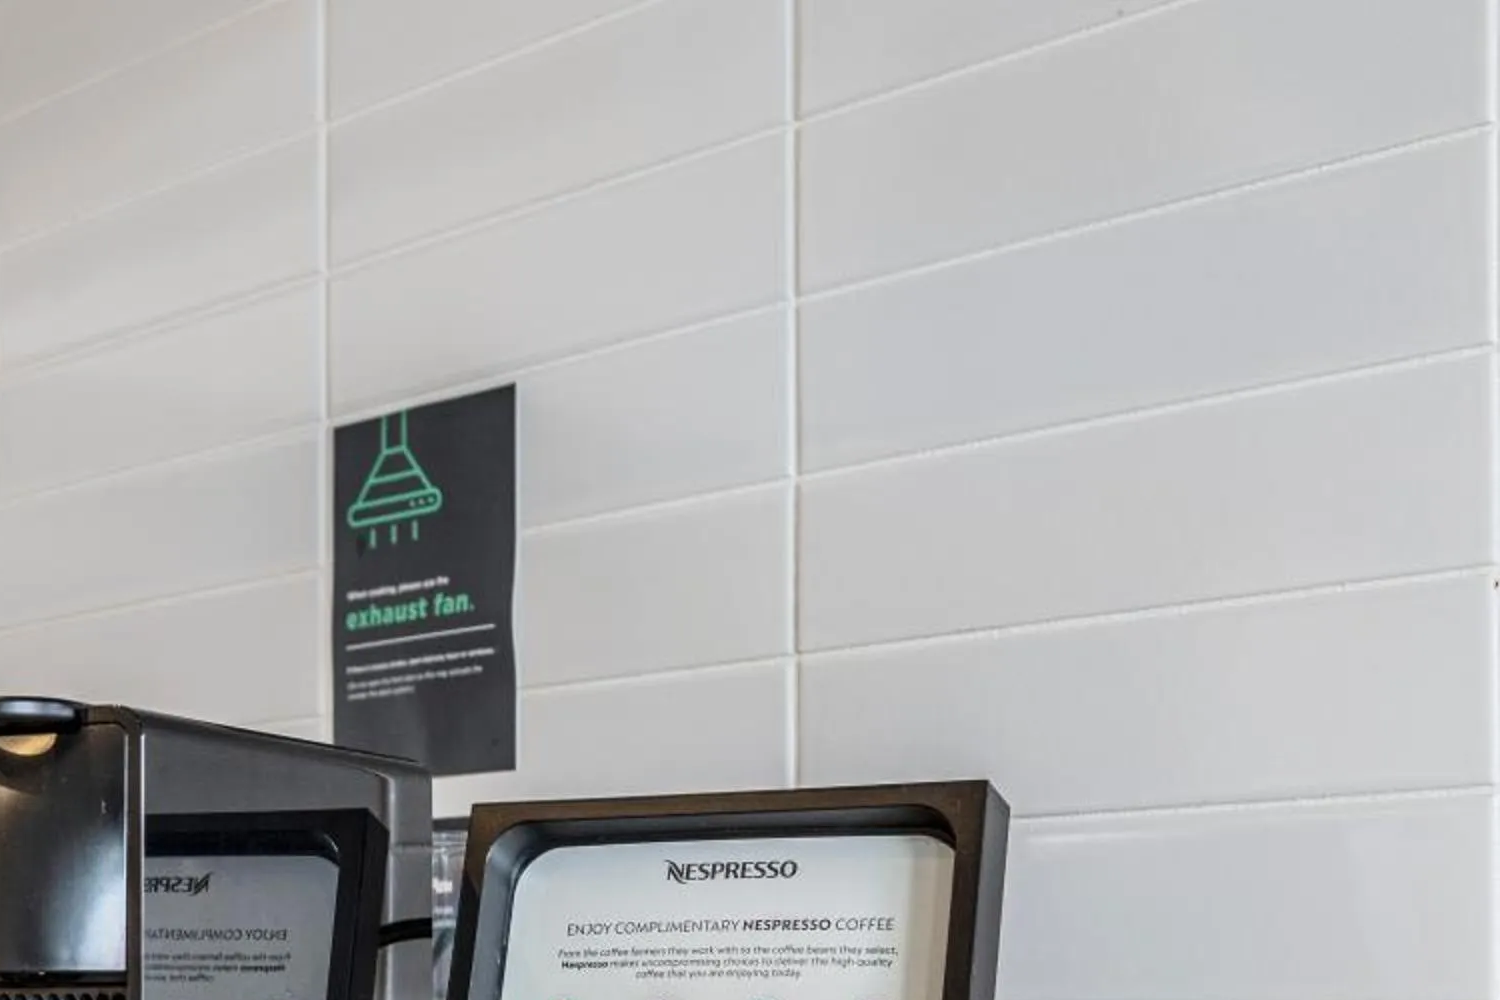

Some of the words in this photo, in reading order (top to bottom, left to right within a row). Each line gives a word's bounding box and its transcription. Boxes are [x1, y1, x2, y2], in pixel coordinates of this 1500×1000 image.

[345, 597, 428, 631] exhaust
[434, 592, 475, 617] fan.
[664, 860, 799, 884] NESPRESSO
[567, 923, 612, 937] ENJOY
[614, 919, 740, 935] COMPLIMENTARY
[743, 919, 832, 931] NESPRESSO
[836, 918, 895, 931] COFFEE
[600, 948, 629, 958] coffee
[691, 946, 714, 955] work
[717, 946, 739, 955] with
[753, 946, 770, 955] the
[772, 945, 805, 955] coffee
[807, 945, 836, 955] beans
[839, 945, 862, 957] they
[562, 961, 609, 971] Nespresso
[811, 956, 829, 966] the
[636, 969, 665, 979] coffee
